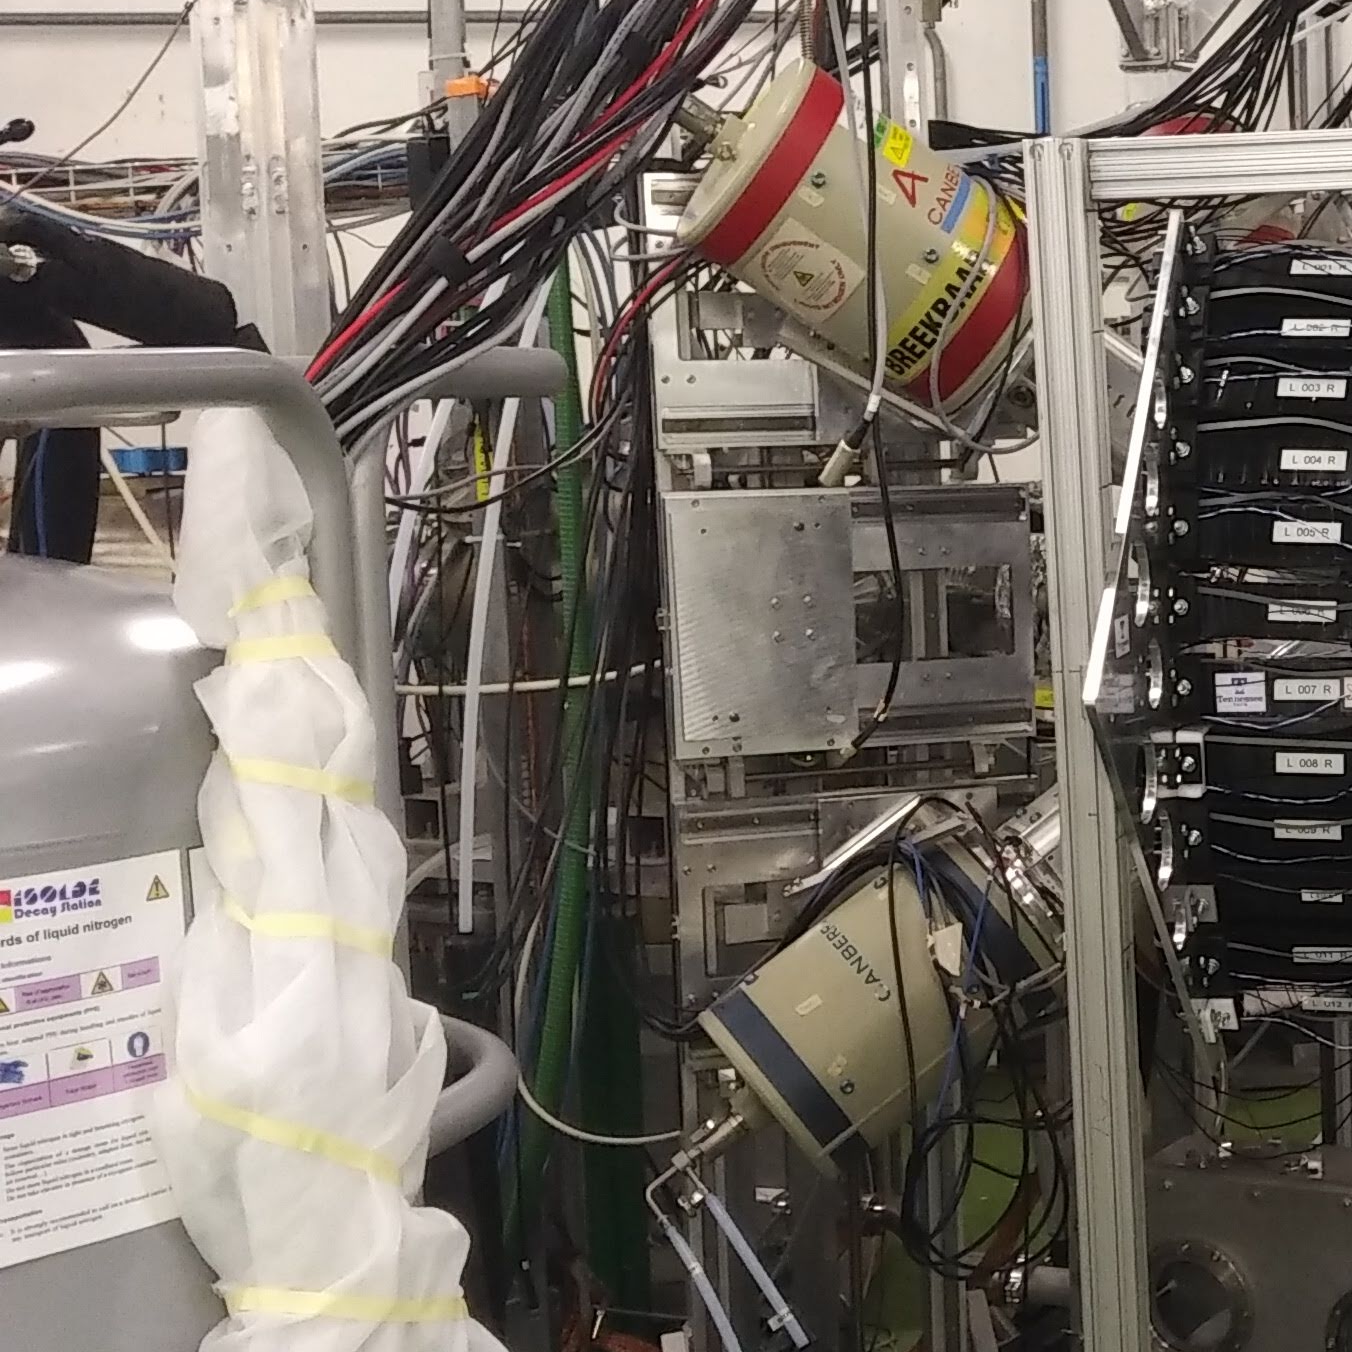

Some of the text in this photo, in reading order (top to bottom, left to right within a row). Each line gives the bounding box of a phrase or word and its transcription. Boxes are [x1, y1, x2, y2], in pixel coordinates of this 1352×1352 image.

[1289, 383, 1335, 392] L 003 R
[1292, 455, 1336, 465] L 004 R
[1285, 528, 1291, 536] L
[1297, 528, 1315, 537] 005
[1285, 685, 1332, 694] L 007 R
[1287, 758, 1333, 768] L 008 R
[14, 878, 100, 907] ISOLDE
[14, 898, 102, 919] Decay Station
[26, 931, 39, 943] of
[43, 924, 79, 940] liquid
[83, 915, 132, 933] nitrogen
